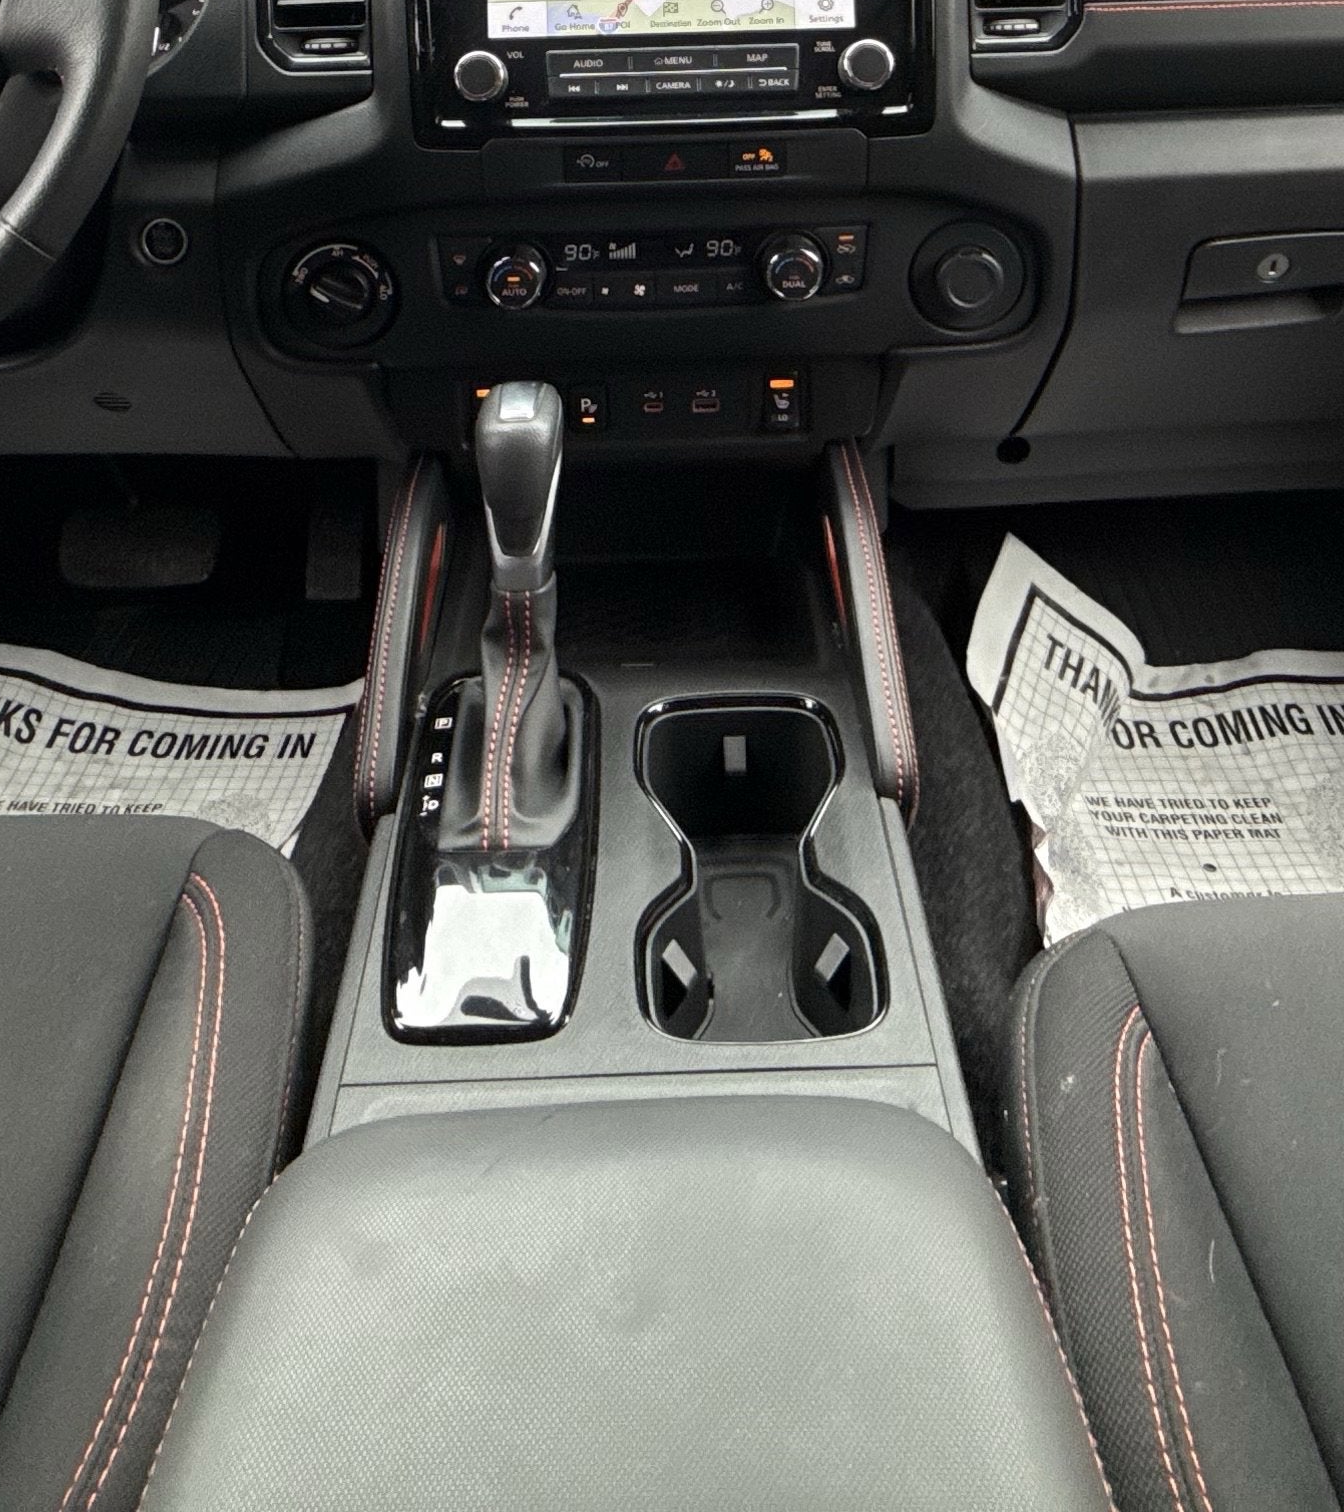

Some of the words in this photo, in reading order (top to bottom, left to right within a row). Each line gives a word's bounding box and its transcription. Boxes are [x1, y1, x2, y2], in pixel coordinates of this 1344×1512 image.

[650, 19, 692, 29] Destination
[697, 18, 723, 28] Zoom
[725, 16, 742, 26] Out
[748, 16, 773, 26] Zoom
[775, 16, 785, 25] In
[808, 14, 844, 25] Settings
[501, 23, 530, 33] Phone
[554, 22, 569, 32] Go
[571, 21, 595, 32] Home
[506, 50, 525, 59] VOL
[746, 53, 768, 63] MAP
[573, 58, 603, 68] AUDIO
[663, 55, 693, 66] MENU
[655, 80, 691, 90] CAMERA
[767, 77, 790, 87] BACK
[742, 152, 755, 161] OFF
[595, 159, 609, 168] OFF
[673, 284, 699, 293] MODE
[726, 281, 743, 290] A/C
[781, 280, 806, 289] DUAL
[501, 288, 527, 296] AUTO
[1111, 717, 1163, 750] OR
[1169, 703, 1315, 749] COMING
[45, 719, 121, 756] FOR
[127, 730, 269, 760] COMING
[278, 732, 317, 759] IN
[431, 752, 443, 764] R
[428, 799, 439, 810] D
[1085, 795, 1110, 808] WE
[1114, 795, 1155, 809] HAVE
[1157, 797, 1206, 810] TRIED
[1206, 798, 1230, 810] TO
[1233, 797, 1272, 809] KEEP
[7, 801, 48, 814] HAVE
[50, 802, 96, 815] TRIED
[104, 804, 122, 815] TO
[123, 803, 164, 815] KEEP
[1089, 809, 1136, 823] YOUR
[1139, 812, 1228, 825] CARPETING
[1231, 813, 1283, 824] CLEAN
[1105, 825, 1148, 839] WITH
[1152, 828, 1189, 840] THIS
[1192, 828, 1245, 840] PAPER
[1248, 828, 1282, 839] MAT
[1170, 886, 1182, 898] A
